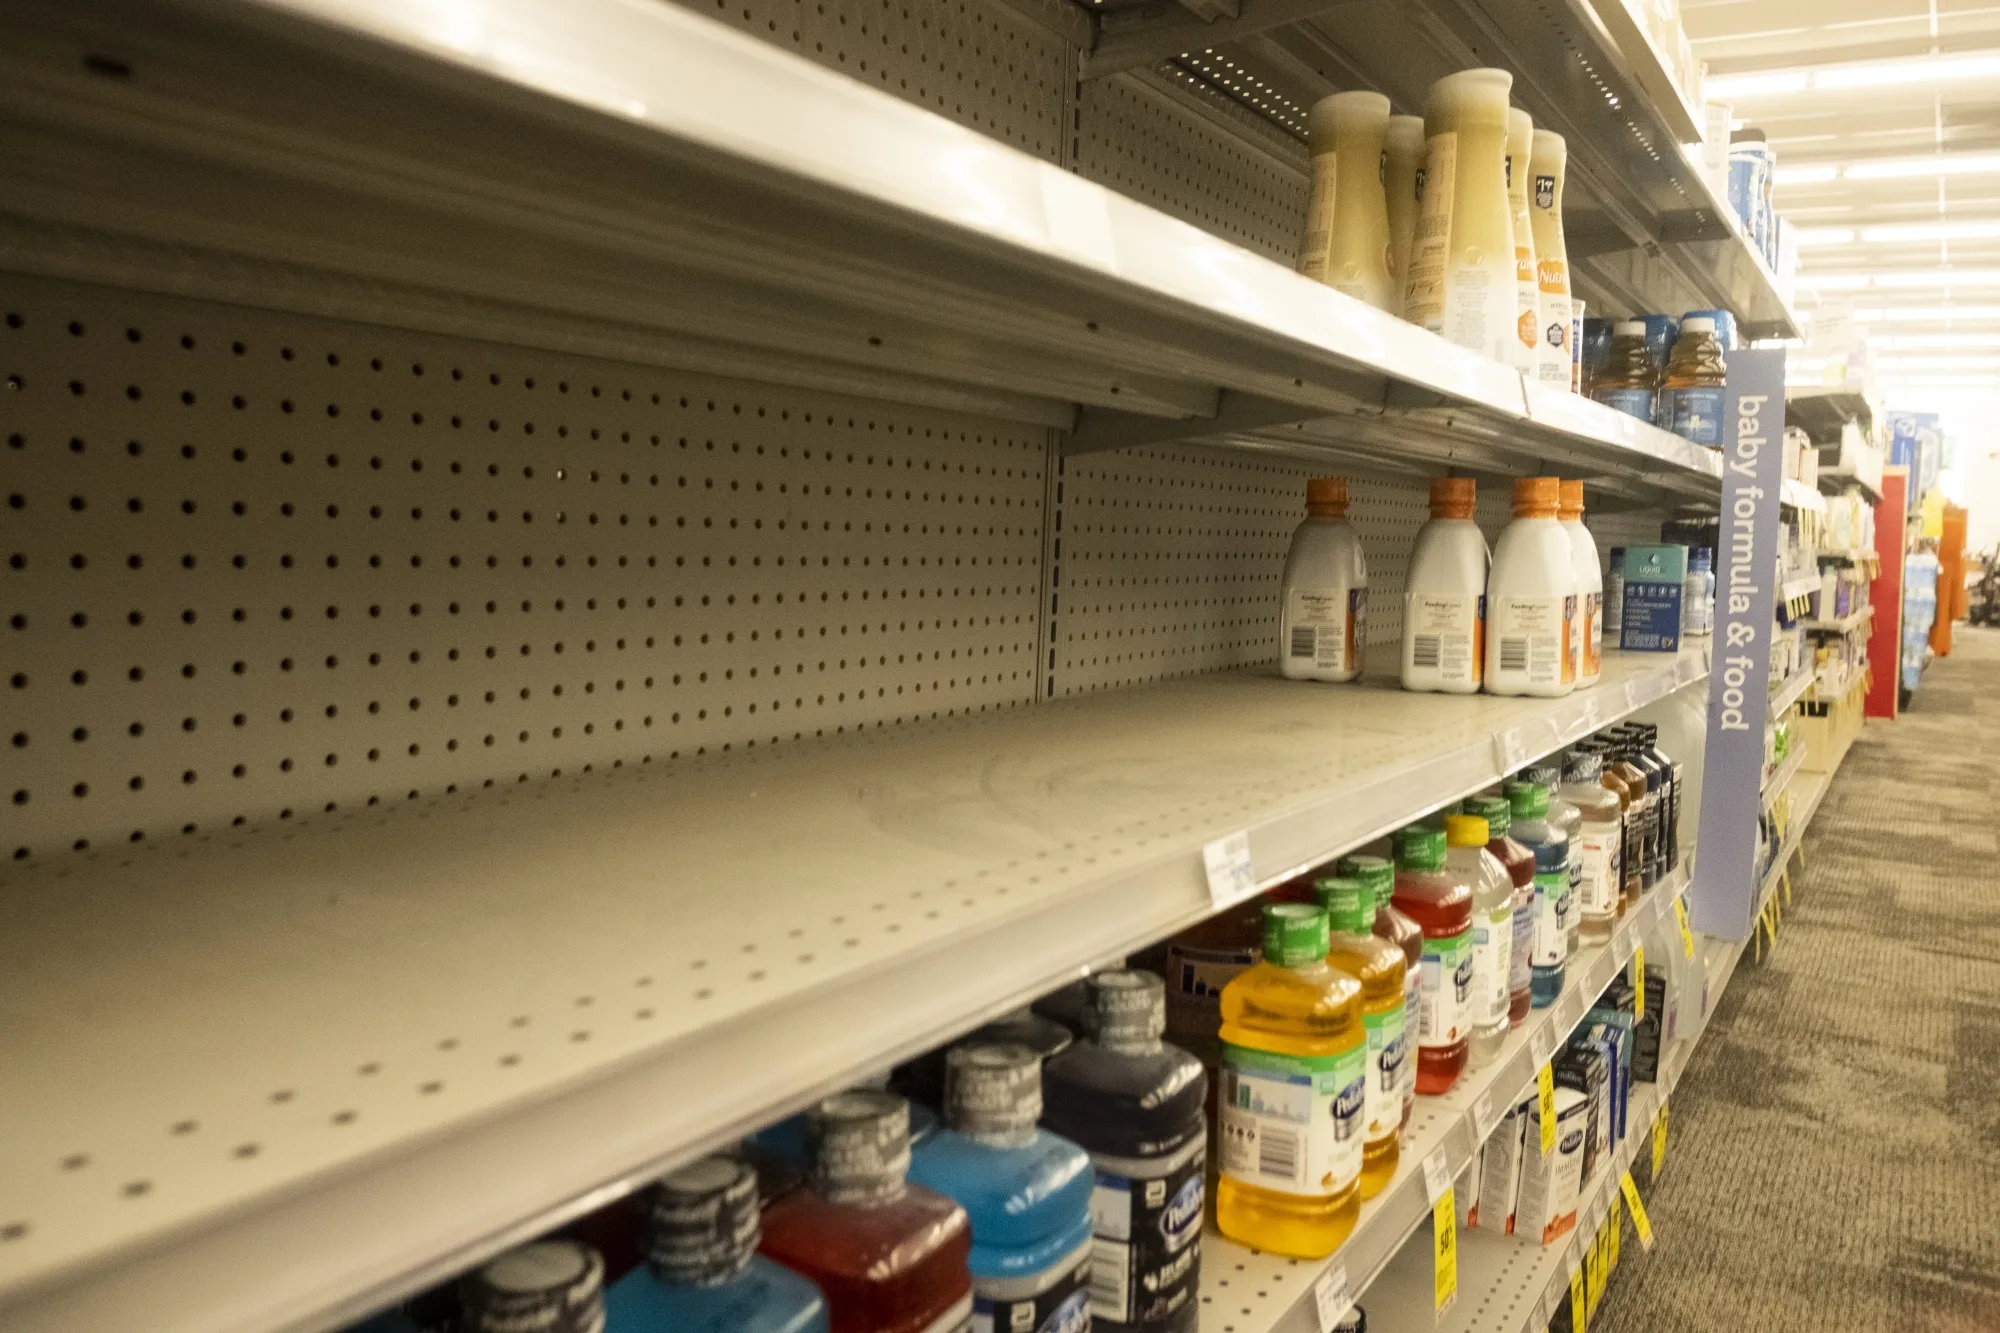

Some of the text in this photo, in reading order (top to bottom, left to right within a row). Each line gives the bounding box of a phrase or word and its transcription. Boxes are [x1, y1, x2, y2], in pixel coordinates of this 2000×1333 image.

[1721, 395, 1768, 731] baby formula & food
